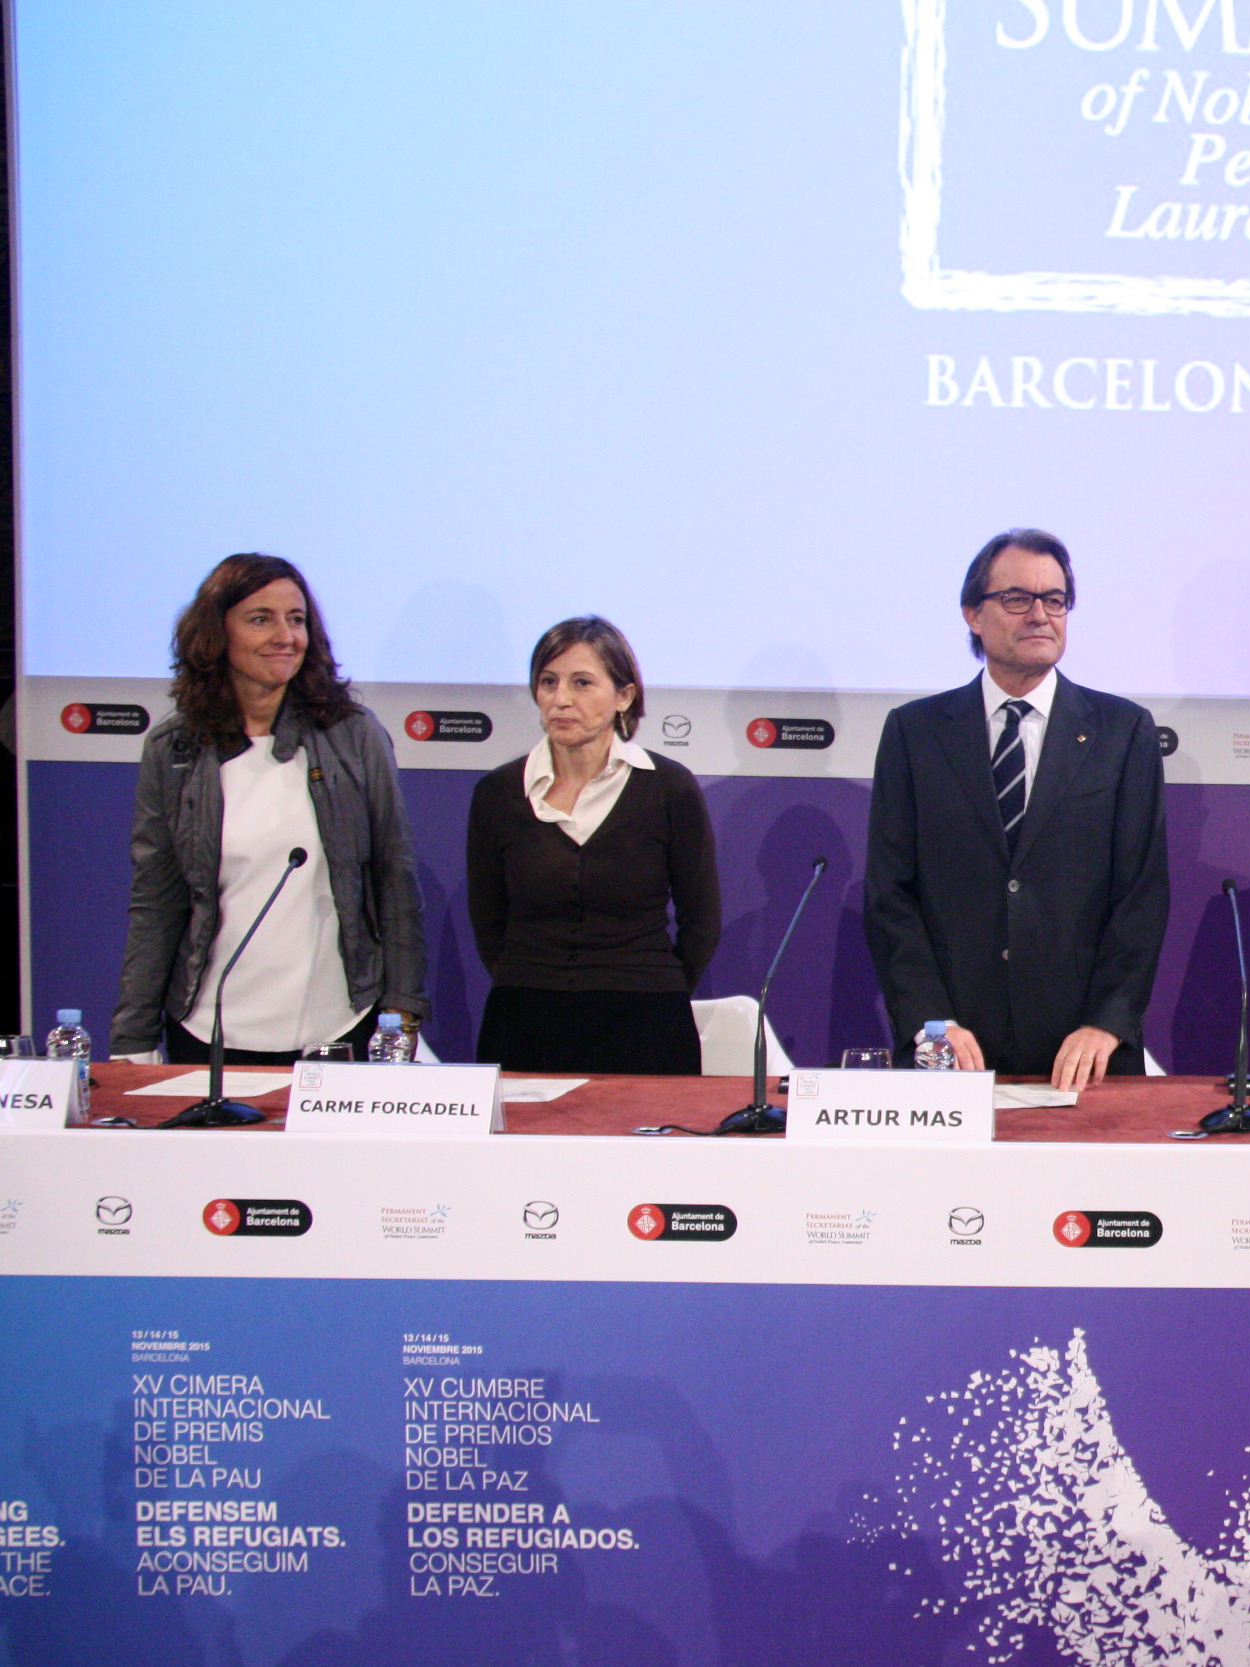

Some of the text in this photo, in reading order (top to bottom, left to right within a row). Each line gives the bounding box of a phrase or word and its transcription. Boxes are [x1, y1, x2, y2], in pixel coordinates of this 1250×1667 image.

[1080, 68, 1149, 136] of
[439, 718, 473, 726] Ajuntament
[439, 725, 482, 734] Barcelona
[781, 733, 824, 741] Barcelona
[300, 1099, 480, 1117] CARME FORCADELL
[815, 1109, 963, 1127] ARTUR MAS
[246, 1207, 287, 1216] Ajuntament
[247, 1216, 300, 1227] Barcelona
[672, 1212, 712, 1221] Ajuntament
[671, 1221, 725, 1231] Barcelona
[1097, 1219, 1138, 1228] Ajuntament
[1097, 1227, 1150, 1237] Barcelona
[806, 1231, 837, 1239] WORLD
[132, 1342, 210, 1351] NOVEMBRE 2015
[403, 1345, 483, 1355] NOVIEMBRE 2015
[132, 1353, 189, 1362] BARCELONA
[403, 1356, 460, 1366] BARCELONA
[132, 1374, 264, 1395] XV CIMERA
[403, 1378, 545, 1399] XV CUMBRE
[134, 1398, 331, 1419] INTERNACIONAL
[405, 1401, 600, 1422] INTERNACIONAL
[134, 1421, 264, 1442] DE PREMIS
[405, 1424, 552, 1446] DE PREMIOS
[134, 1445, 218, 1465] NOBEL
[405, 1447, 488, 1467] NOBEL
[135, 1468, 262, 1488] DE LA PAU
[405, 1470, 529, 1491] DE LA PAZ
[136, 1501, 278, 1522] DEFENSEM
[407, 1503, 570, 1524] DEFENDER A
[136, 1526, 346, 1548] ELS REFUGIATS.
[407, 1527, 640, 1550] LOS REFUGIADOS.
[0, 1551, 52, 1573] THE
[136, 1551, 308, 1573] ACONSEGUIM
[409, 1552, 558, 1573] CONSEGUIR
[137, 1575, 232, 1596] LA PAU.
[410, 1576, 500, 1597] LA PAZ.
